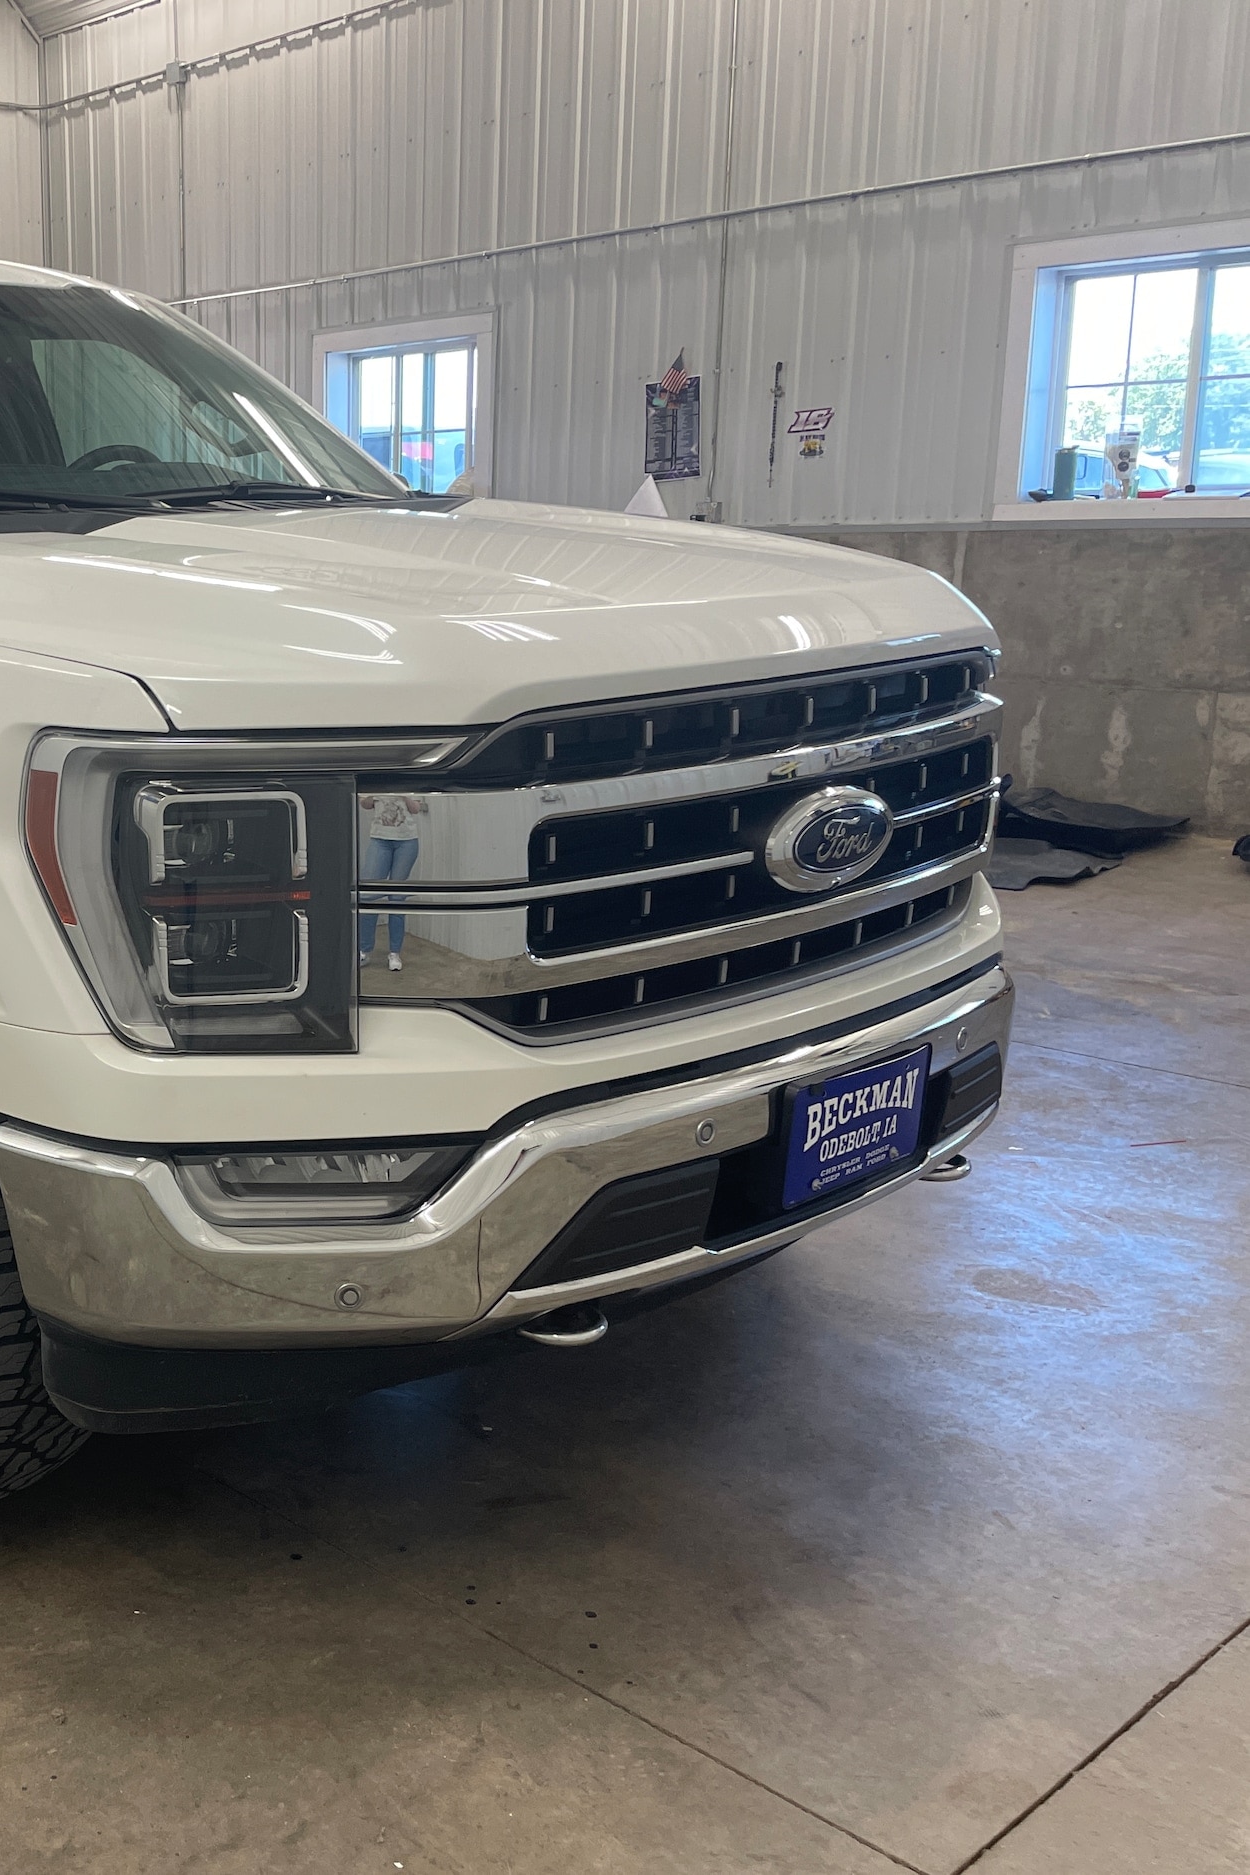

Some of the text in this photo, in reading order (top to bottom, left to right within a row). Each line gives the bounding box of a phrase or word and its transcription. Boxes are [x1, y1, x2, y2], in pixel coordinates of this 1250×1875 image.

[816, 816, 875, 863] Ford
[803, 1068, 919, 1152] BECKMAN
[820, 1115, 897, 1162] ODEBOLT, IA
[820, 1156, 861, 1177] CHRYSLER
[845, 1163, 863, 1176] RAM
